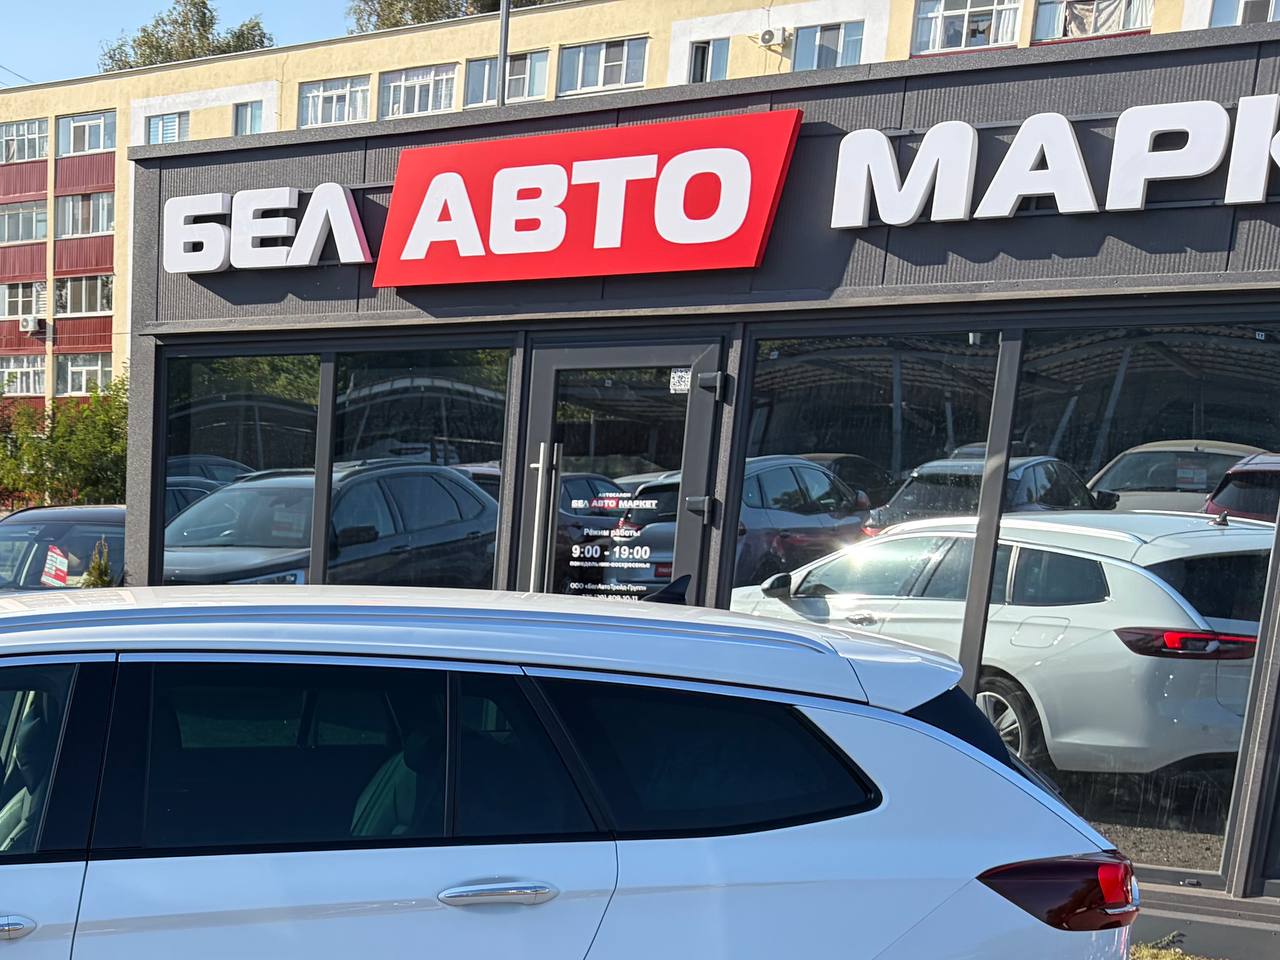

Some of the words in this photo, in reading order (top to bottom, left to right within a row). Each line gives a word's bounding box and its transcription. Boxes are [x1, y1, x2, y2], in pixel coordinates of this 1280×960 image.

[163, 182, 373, 273] БЕЛ
[400, 146, 753, 261] АВТО
[591, 499, 617, 508] АВТО
[618, 499, 658, 509] МАРКЕТ
[583, 528, 609, 536] Режим
[610, 527, 640, 538] работы
[571, 544, 601, 558] 9:00
[613, 545, 651, 559] 19:00
